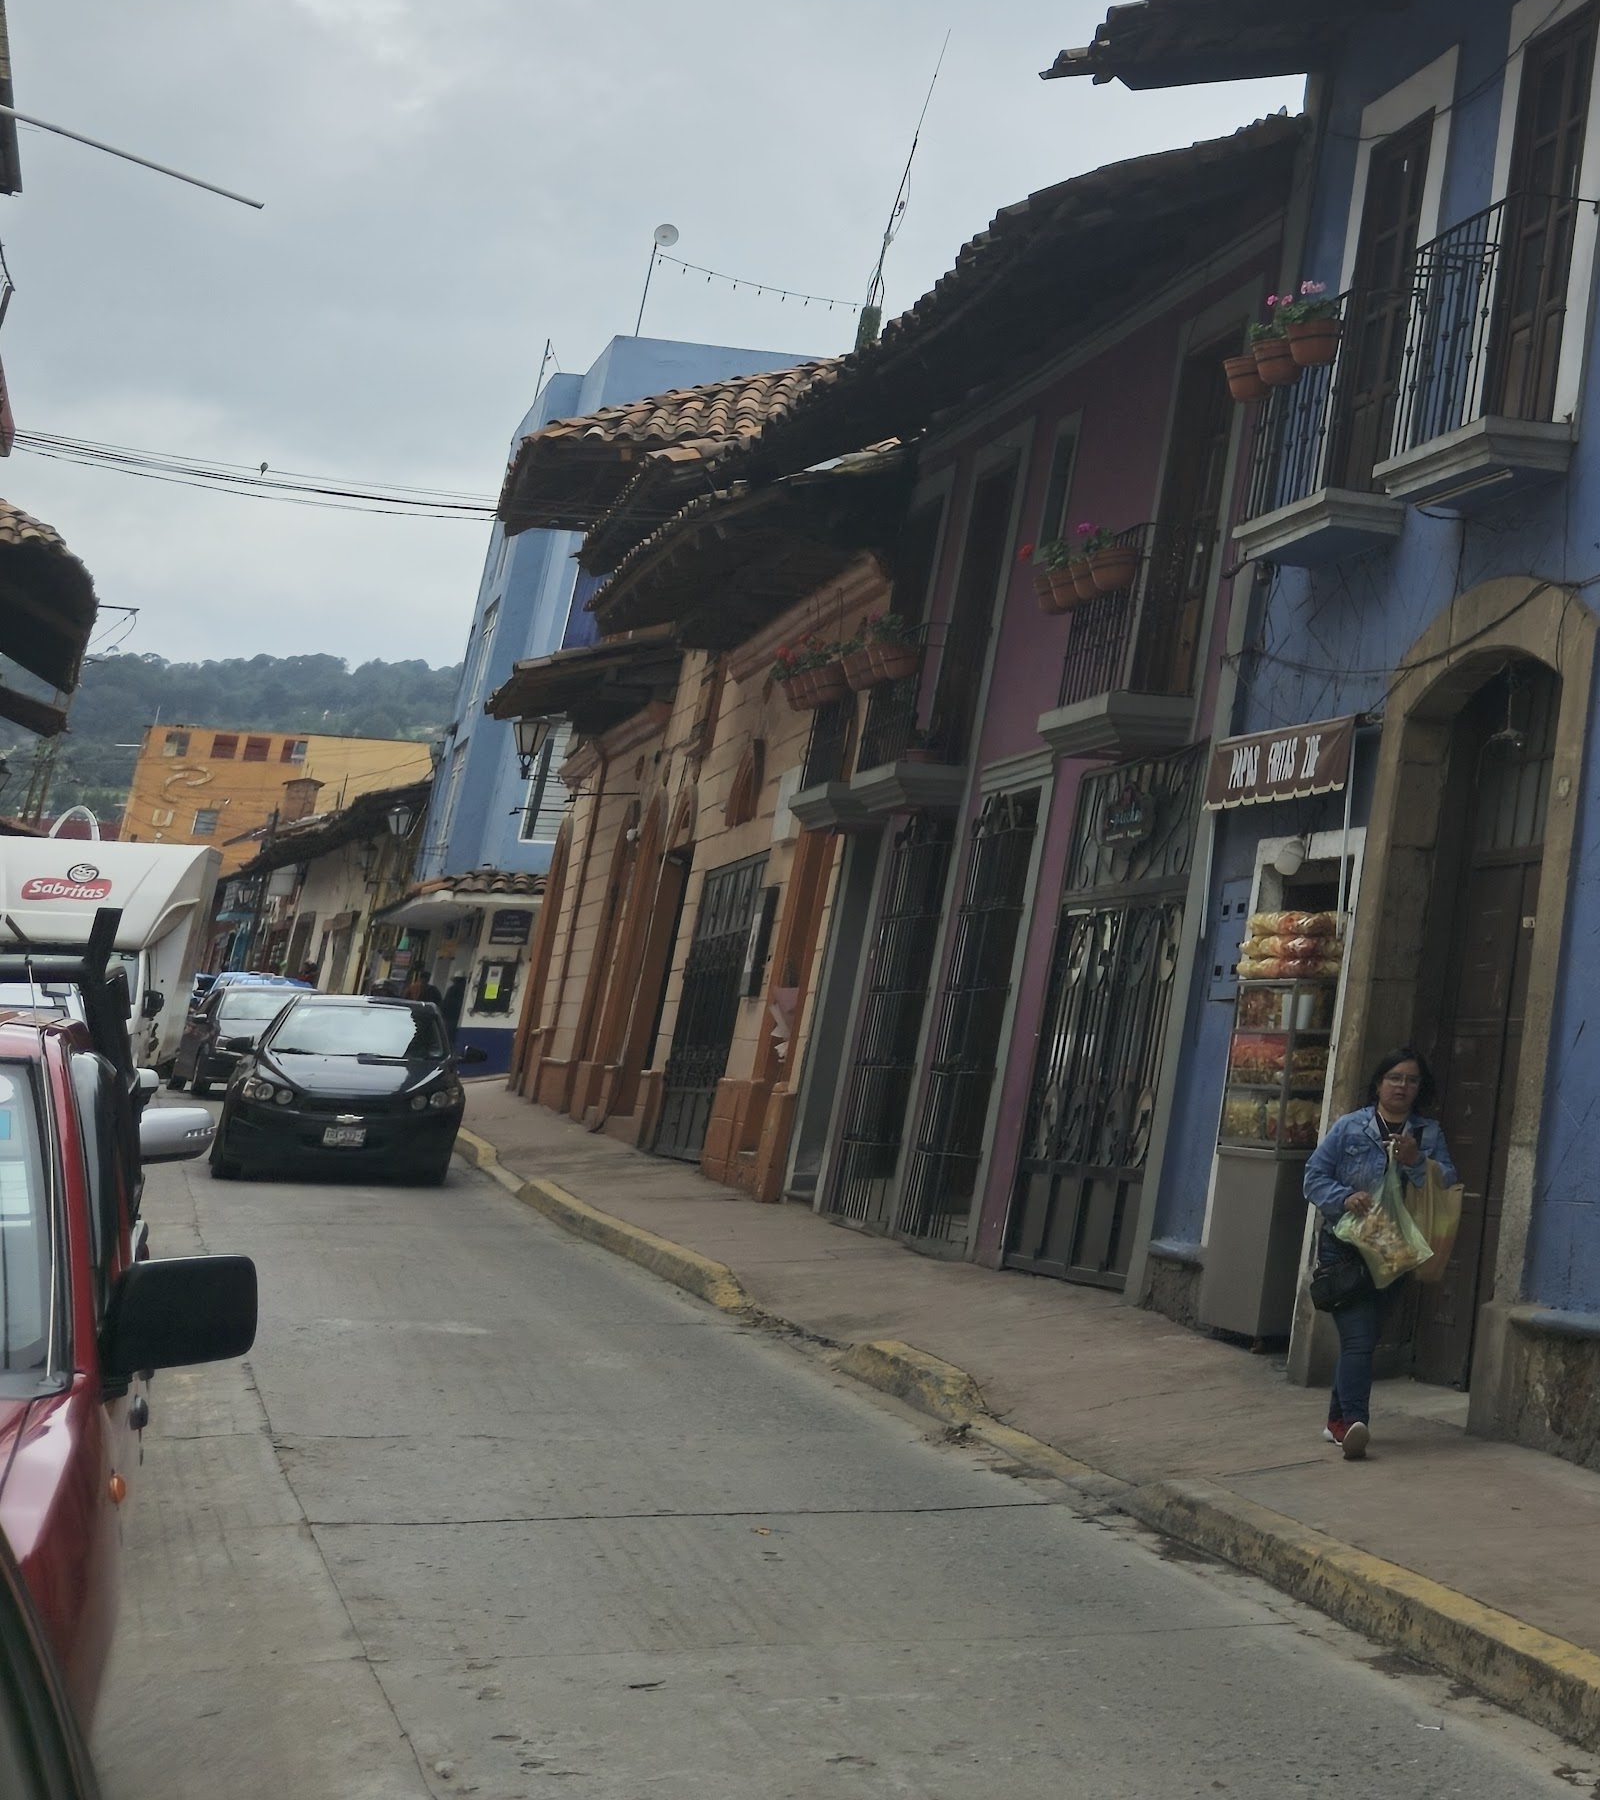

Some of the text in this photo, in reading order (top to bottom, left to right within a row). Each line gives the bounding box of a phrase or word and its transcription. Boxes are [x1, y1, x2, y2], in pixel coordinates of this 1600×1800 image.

[1228, 745, 1261, 789] PAPAS
[1266, 736, 1298, 784] FRITAS
[28, 880, 105, 899] Sabritas
